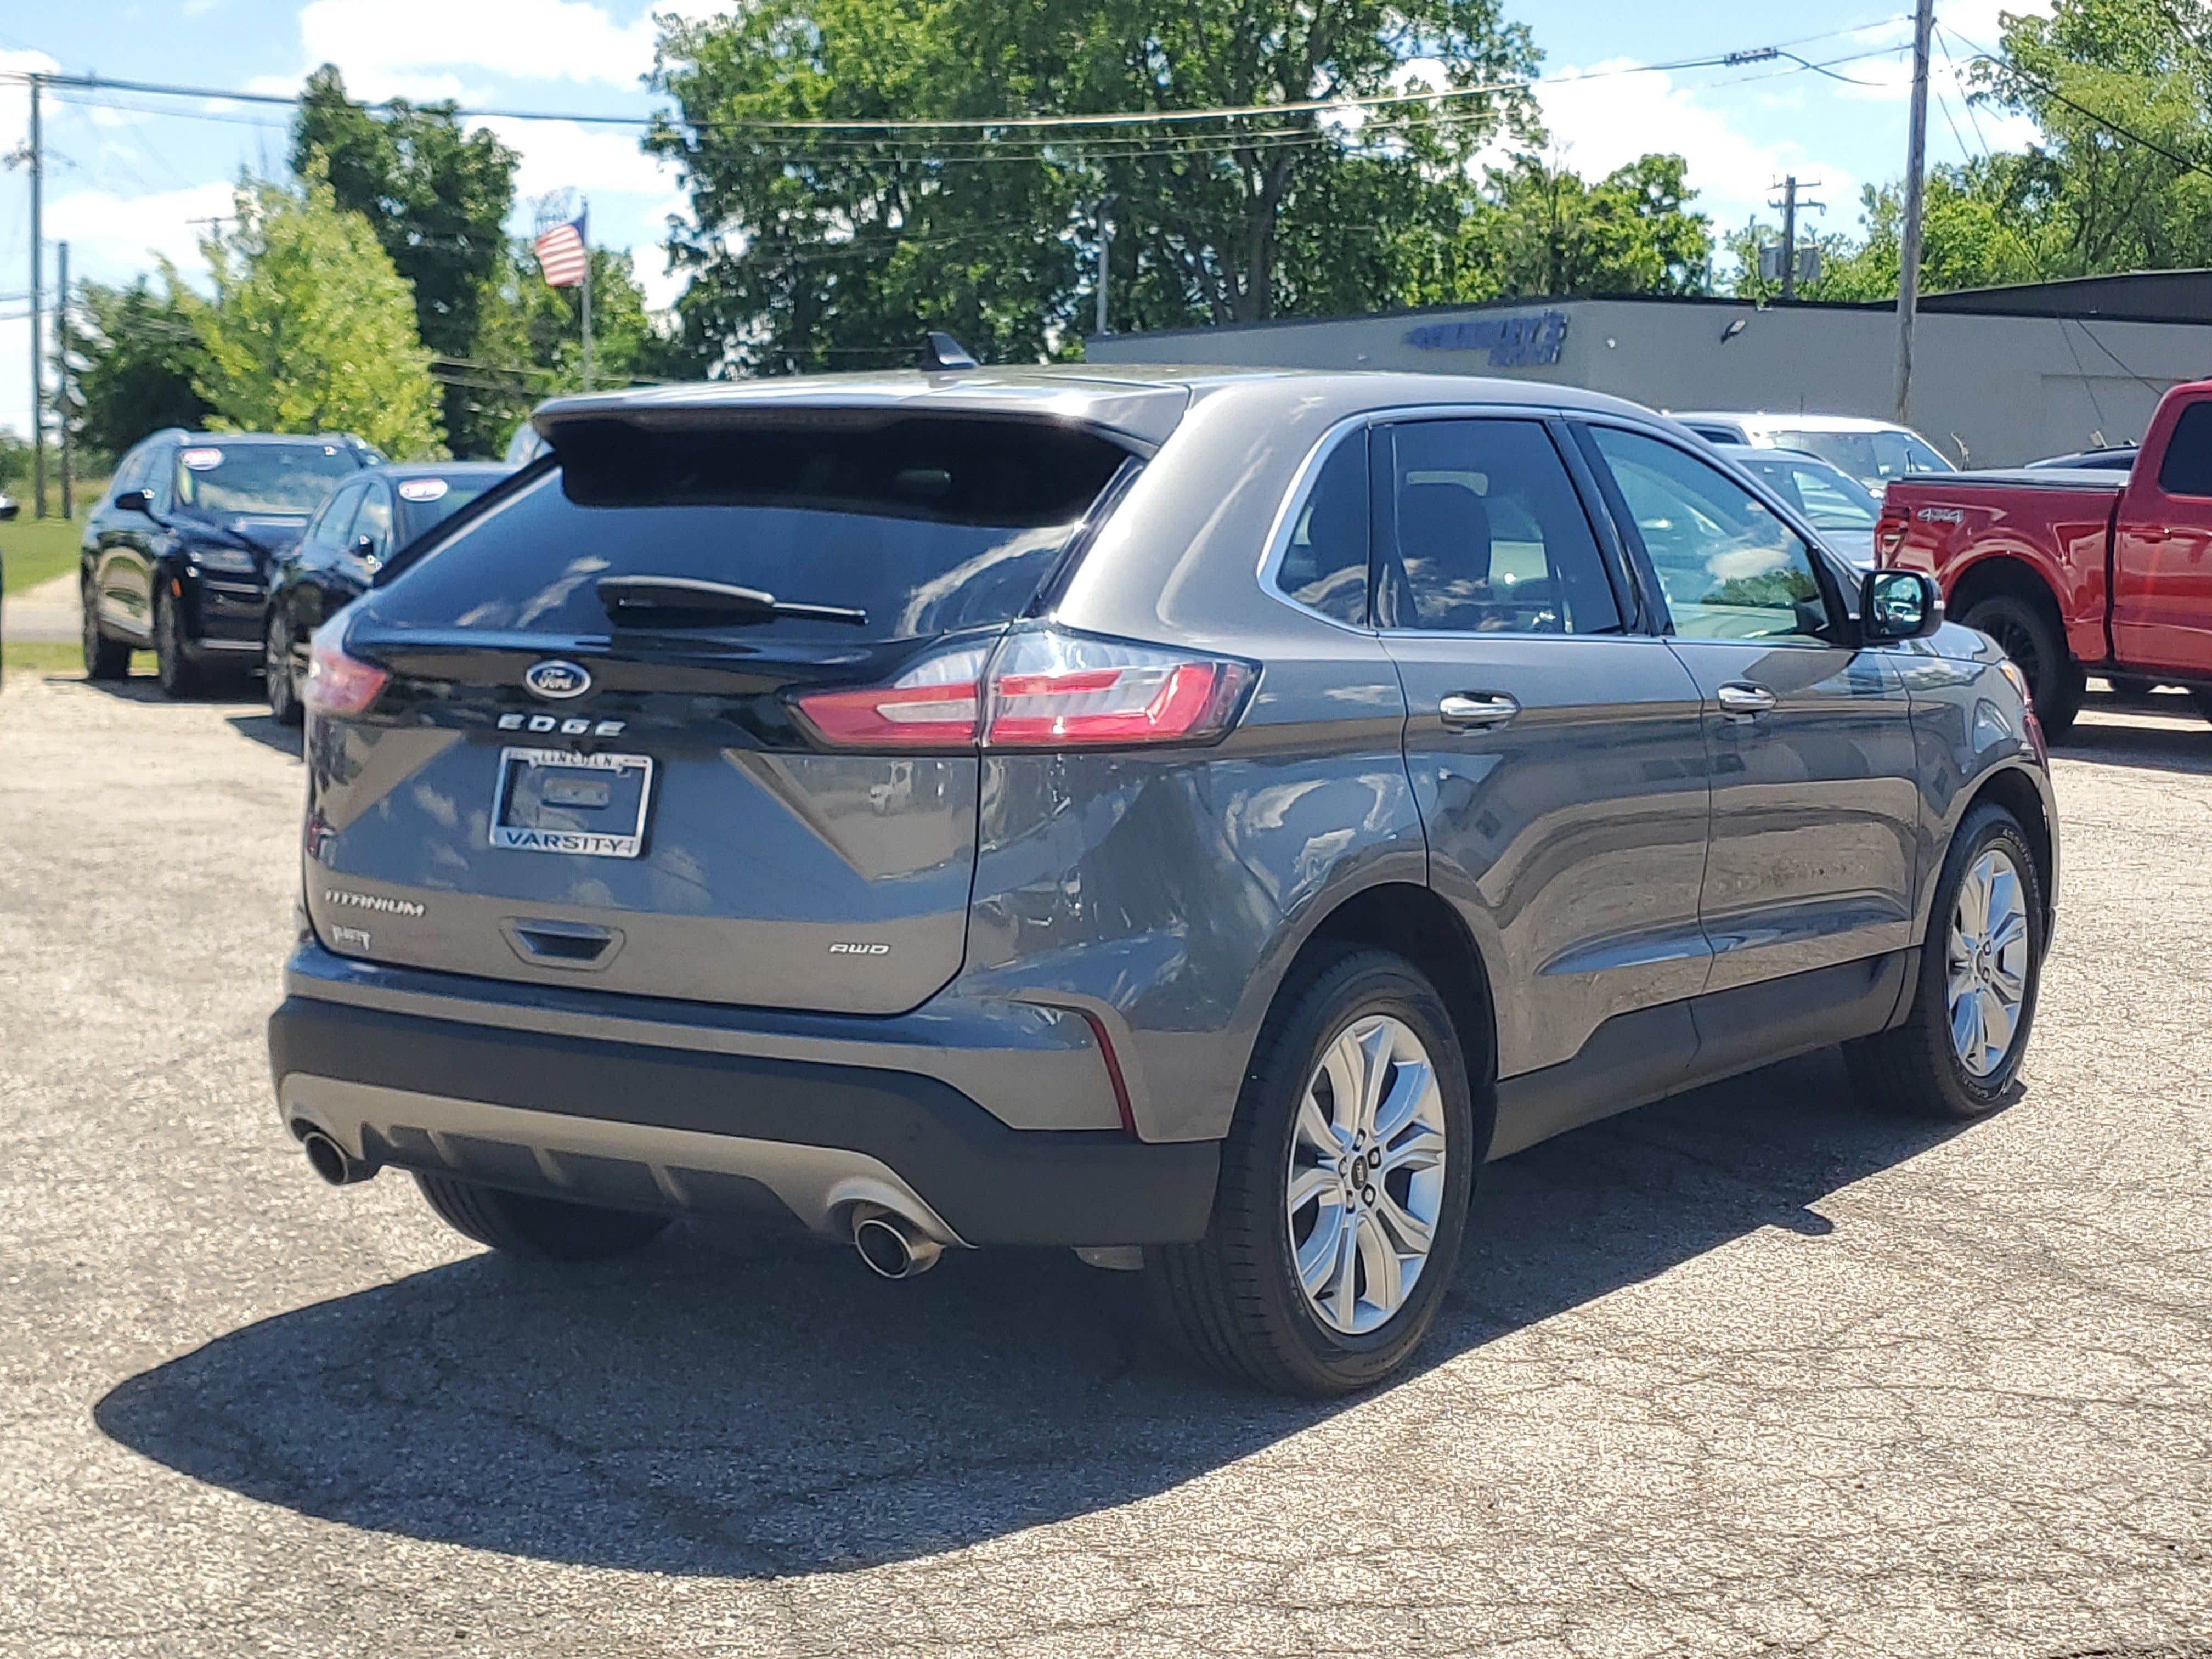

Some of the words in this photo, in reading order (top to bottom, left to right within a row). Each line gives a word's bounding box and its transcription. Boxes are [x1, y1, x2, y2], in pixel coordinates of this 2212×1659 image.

[538, 668, 575, 690] Ford
[498, 713, 627, 737] EDGE
[506, 831, 623, 853] VARSITY
[325, 889, 426, 917] TITANIUM
[828, 943, 890, 955] AWD
